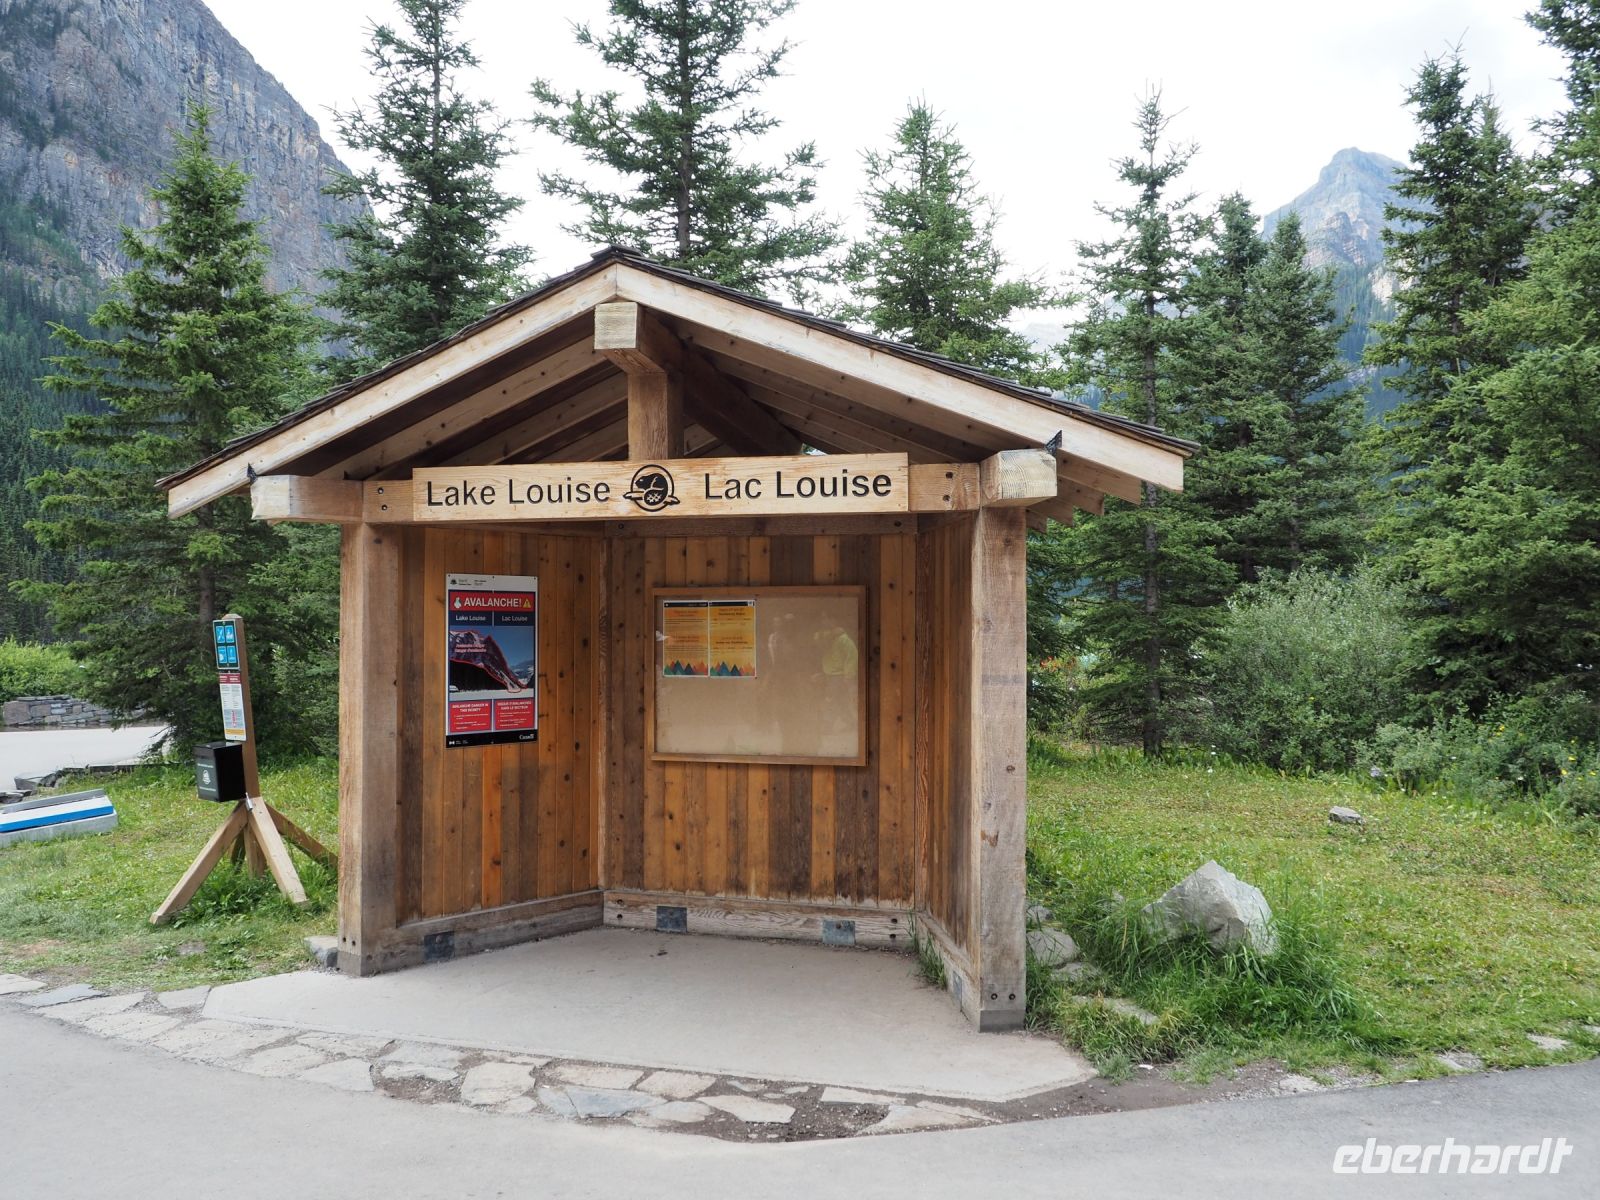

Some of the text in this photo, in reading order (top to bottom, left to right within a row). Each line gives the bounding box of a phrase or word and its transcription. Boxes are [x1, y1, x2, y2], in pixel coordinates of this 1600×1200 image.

[427, 476, 611, 507] Lake Louise
[704, 468, 893, 501] Lac Louise
[464, 597, 521, 607] AVALANCHE!
